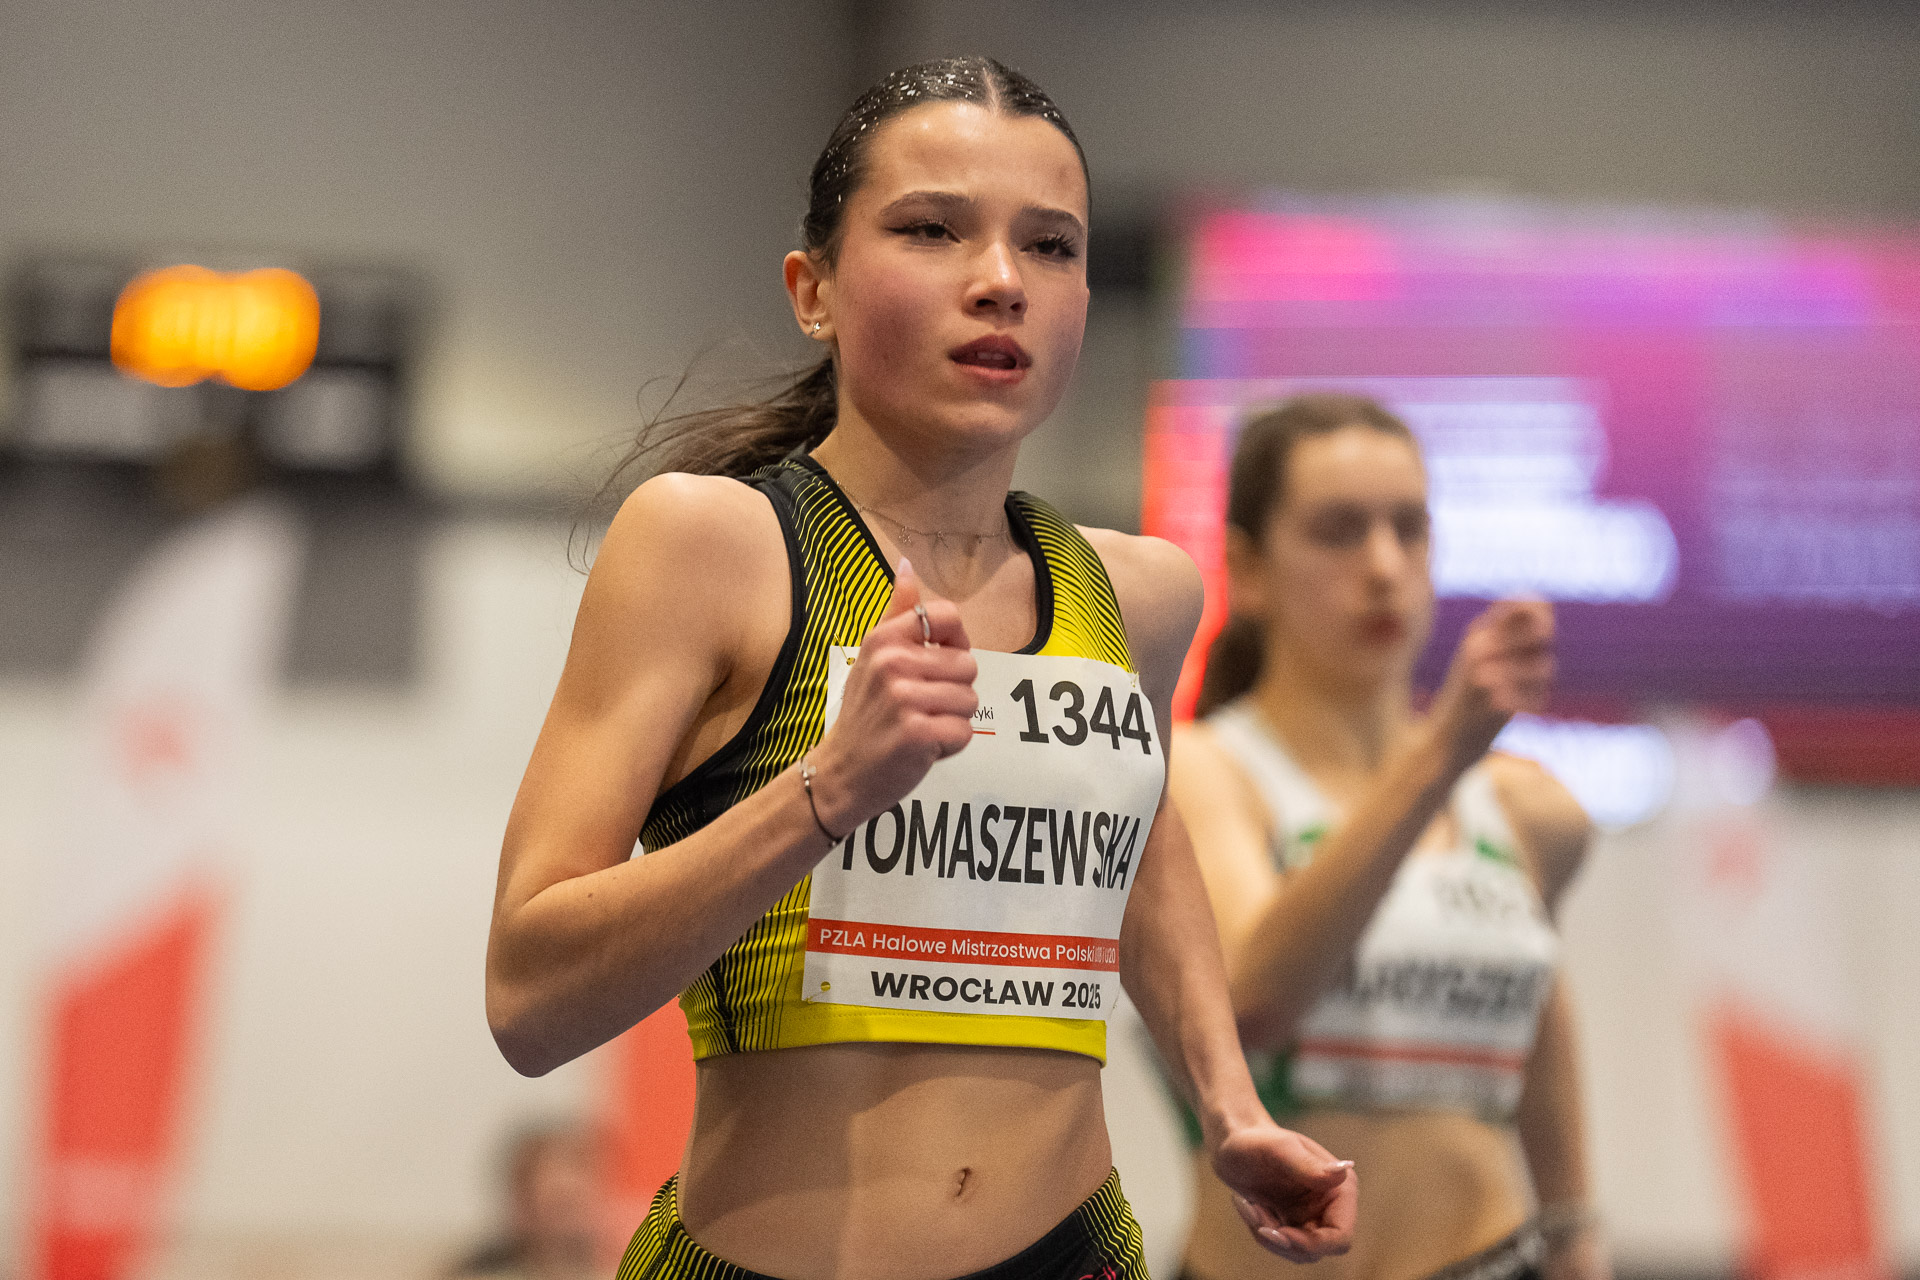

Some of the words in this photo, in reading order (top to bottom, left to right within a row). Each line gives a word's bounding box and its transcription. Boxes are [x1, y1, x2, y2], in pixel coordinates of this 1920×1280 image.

[1010, 678, 1152, 756] 1344
[819, 928, 867, 948] PZLA
[872, 933, 947, 955] Halowe
[951, 938, 1051, 960] Mistrzostwa
[1056, 944, 1095, 962] Polski
[870, 970, 1055, 1008] WROCŁAW
[1061, 981, 1101, 1009] 2025
